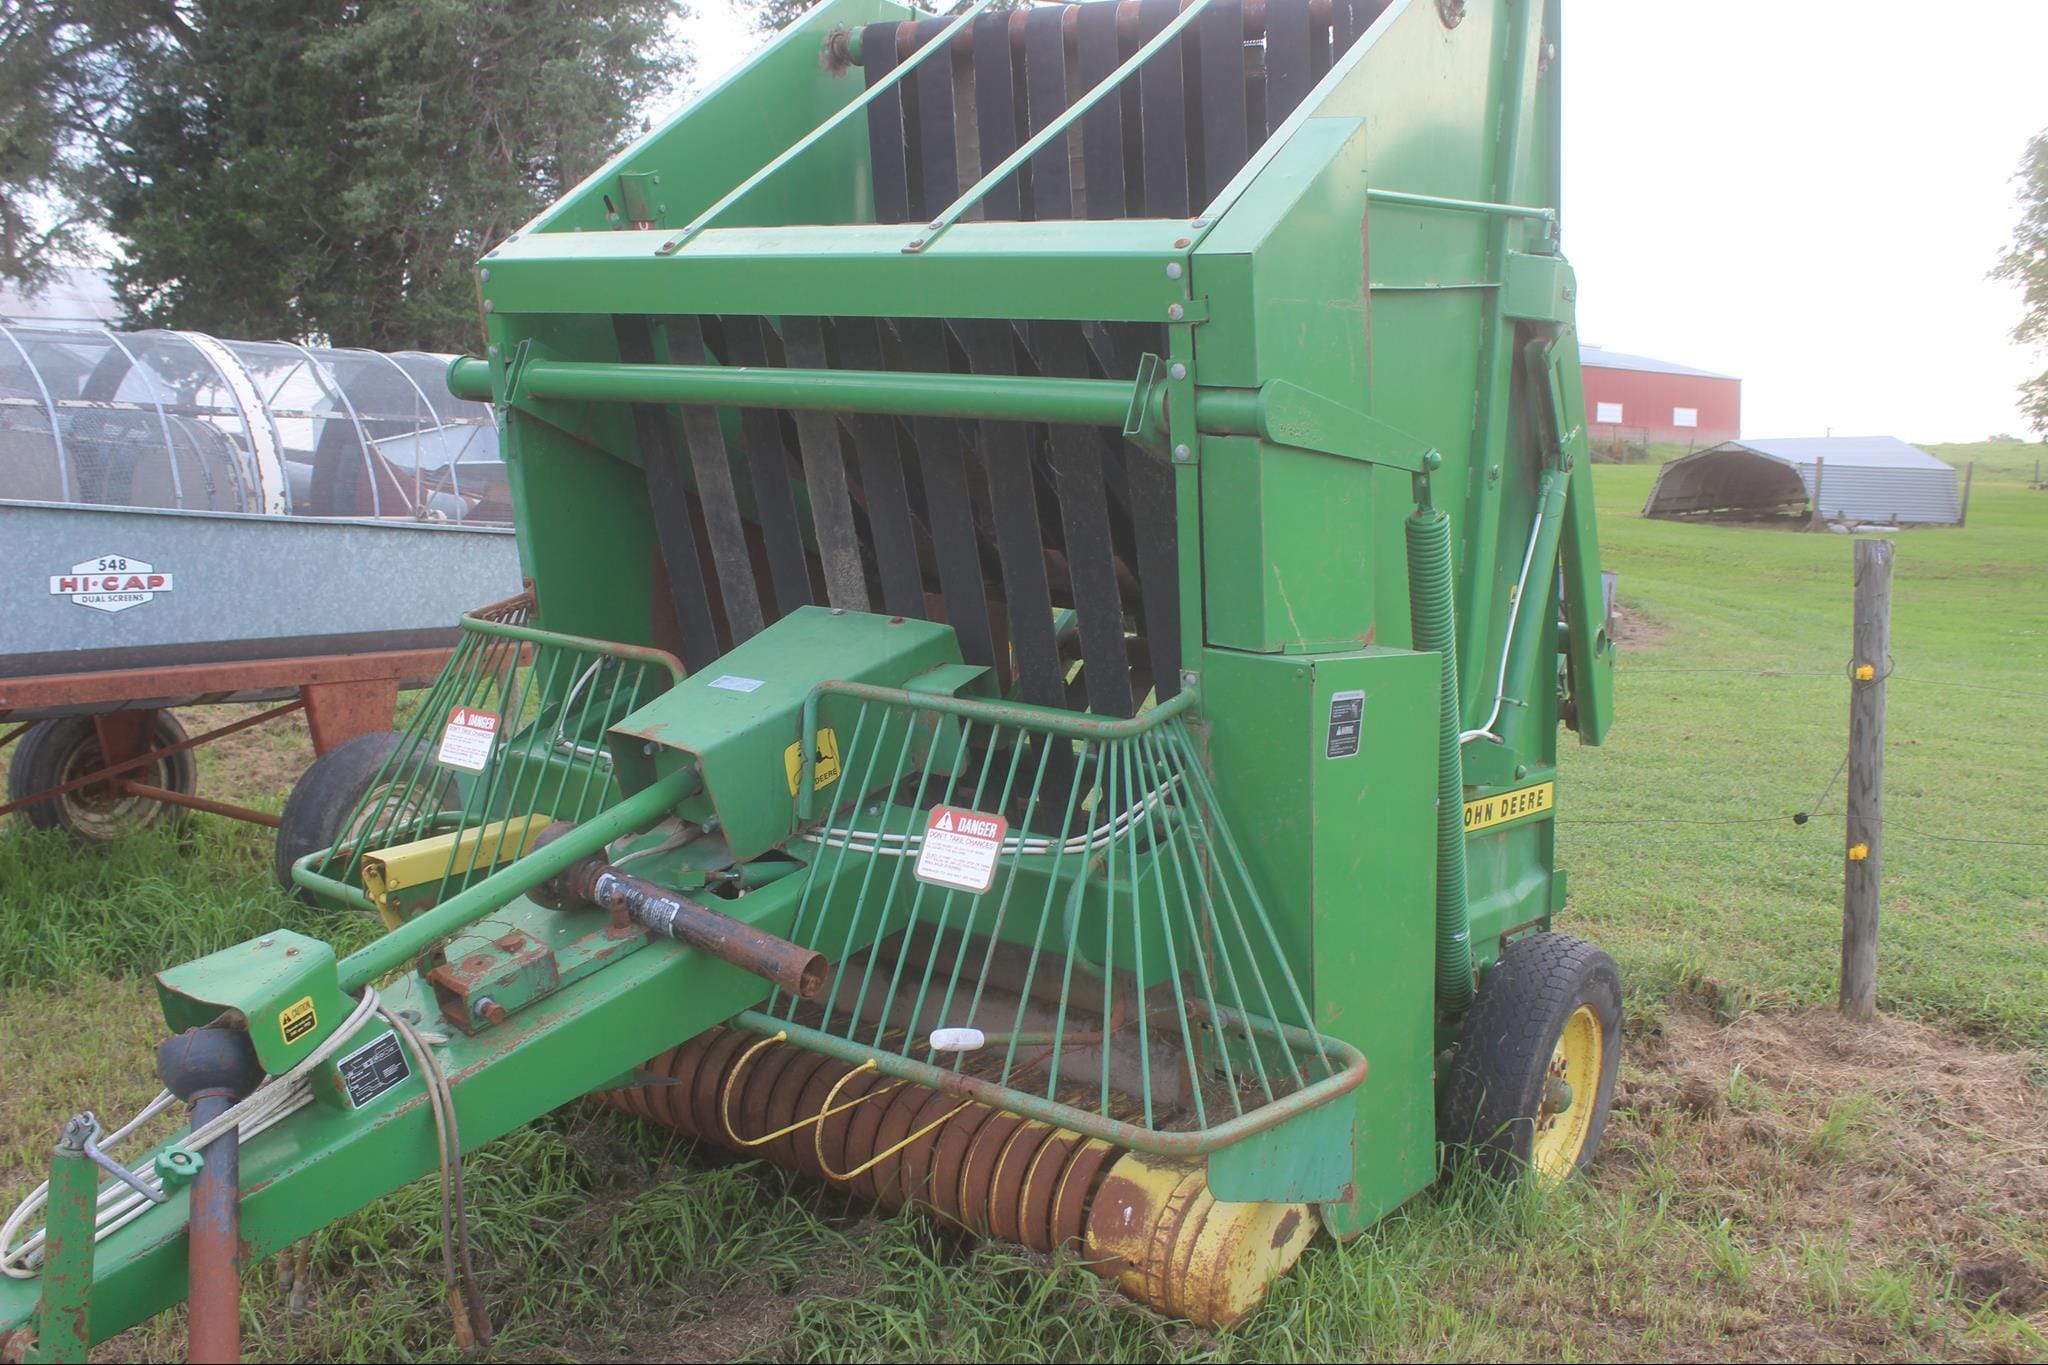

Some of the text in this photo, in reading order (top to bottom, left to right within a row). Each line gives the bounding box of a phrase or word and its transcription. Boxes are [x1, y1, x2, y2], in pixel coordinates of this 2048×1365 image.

[98, 559, 127, 571] 548
[108, 594, 144, 603] SCREENS
[1464, 789, 1544, 827] OHN DEERE
[957, 817, 998, 839] DANGER
